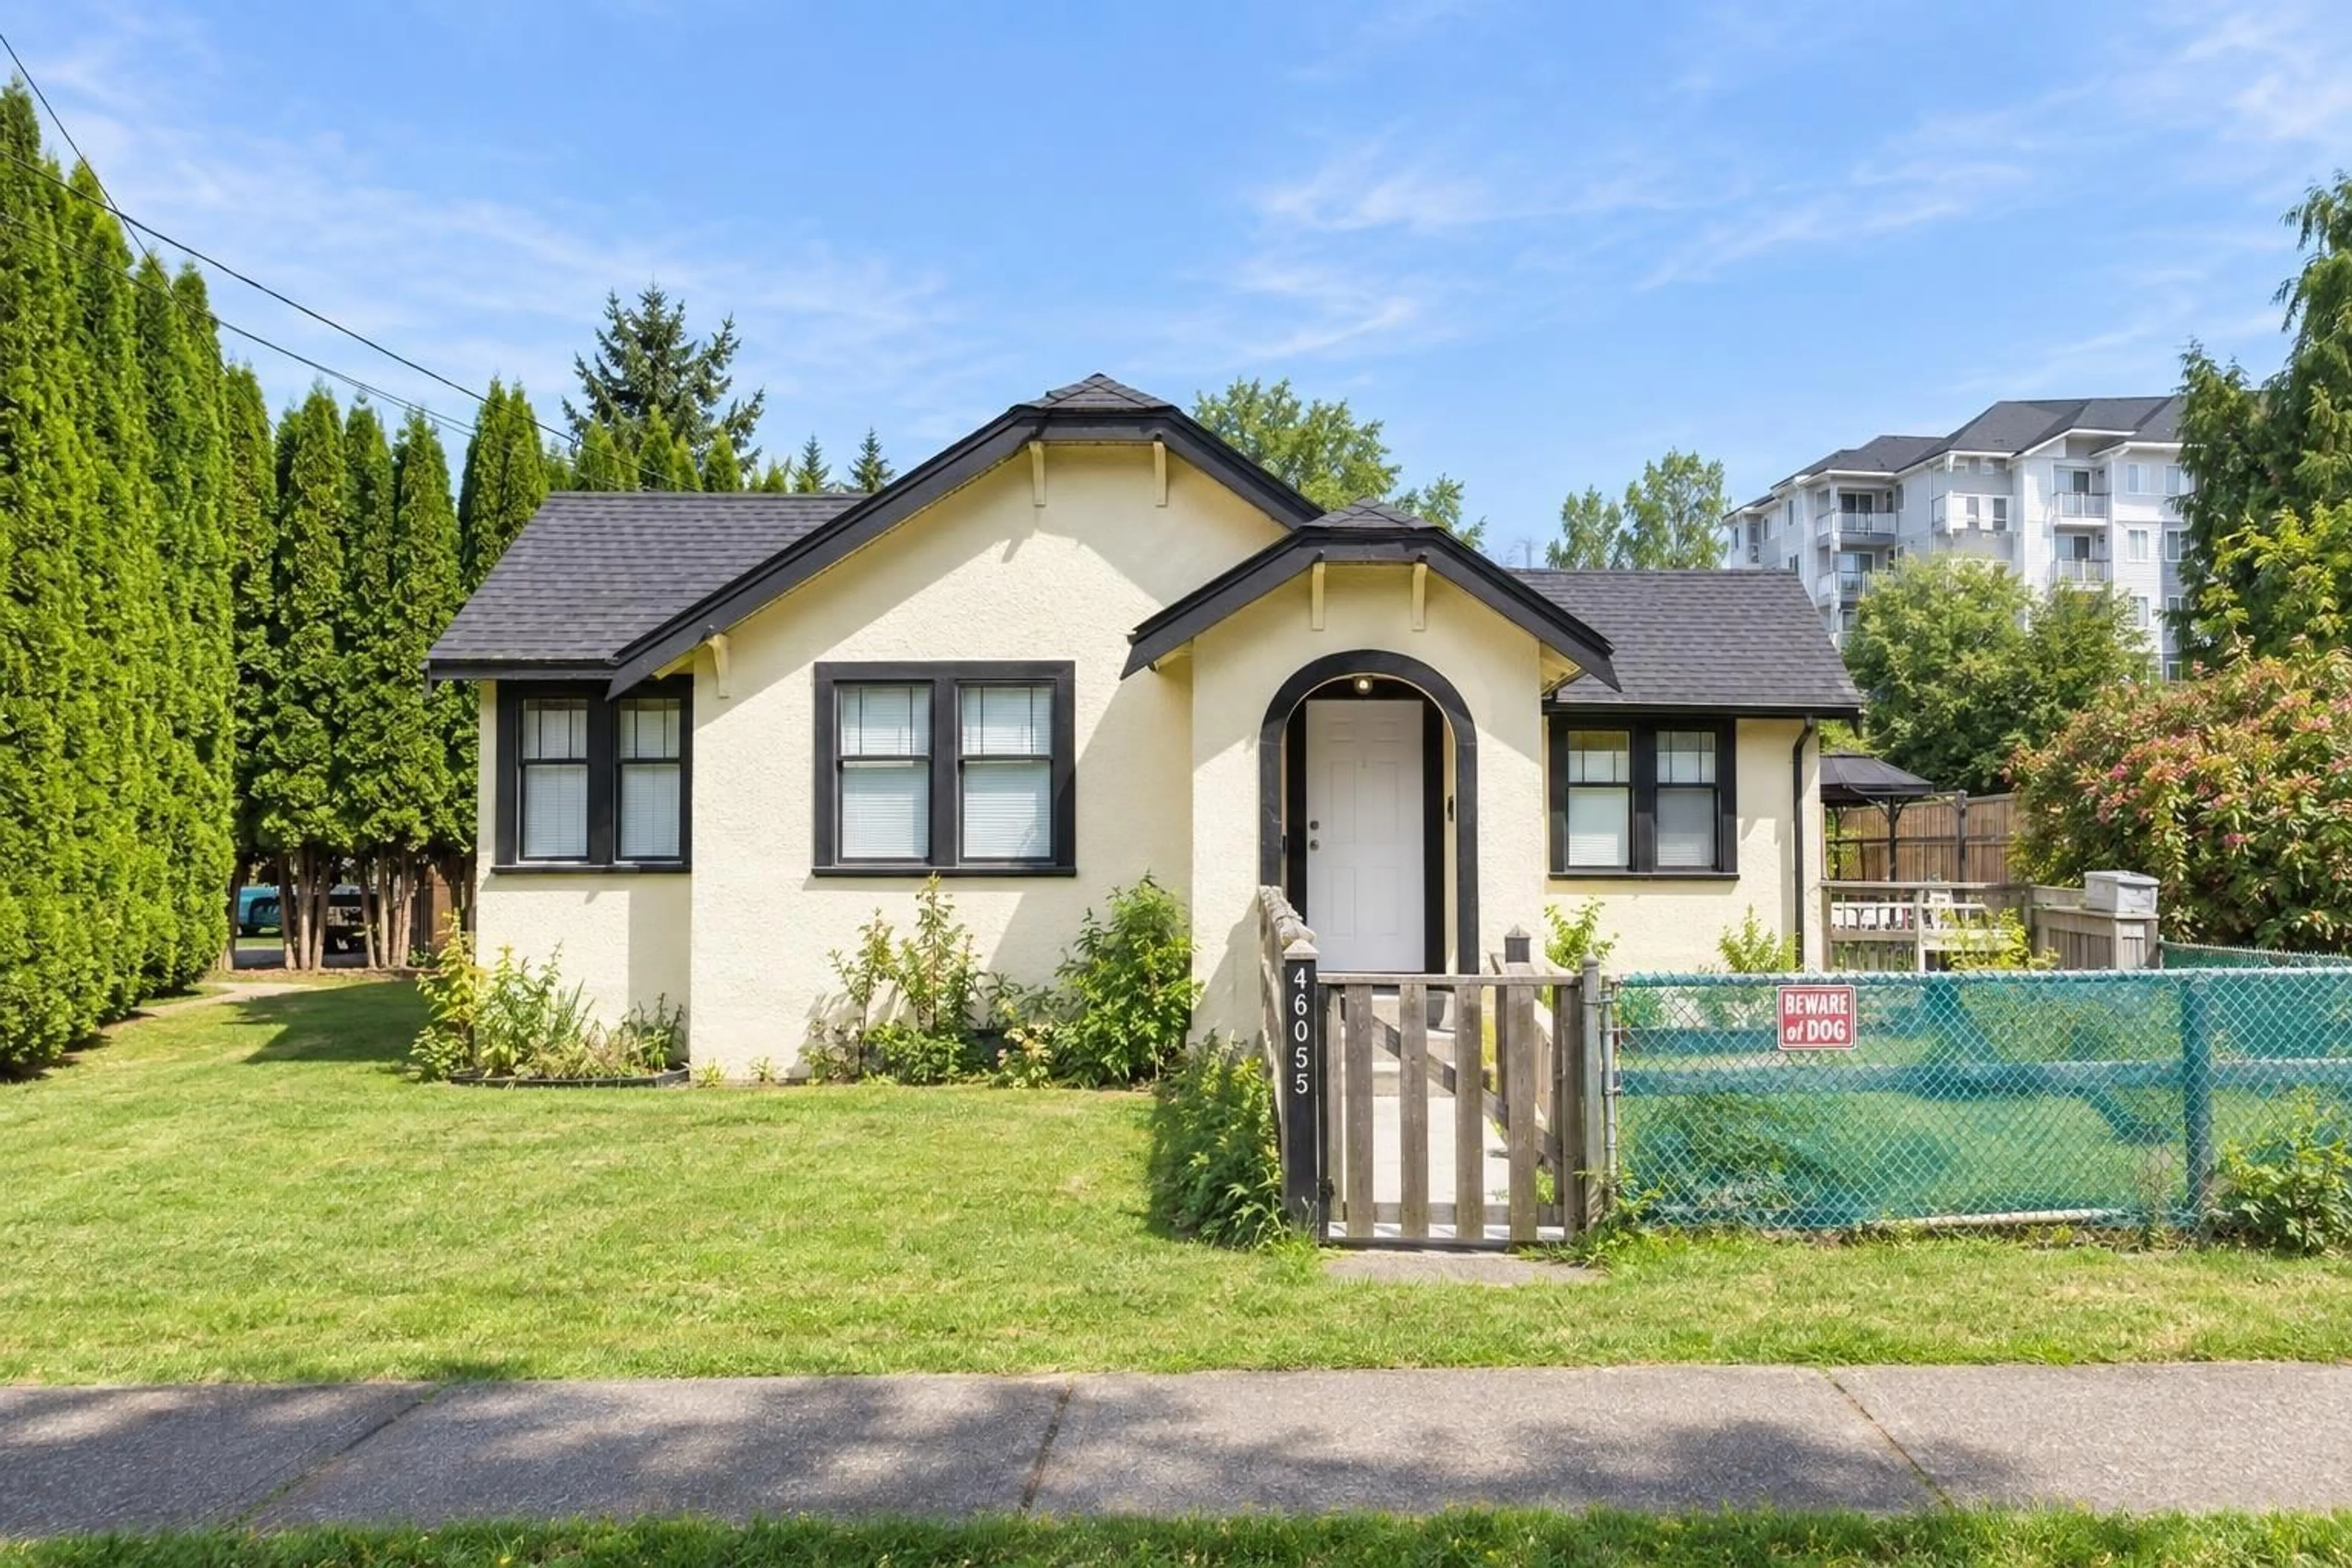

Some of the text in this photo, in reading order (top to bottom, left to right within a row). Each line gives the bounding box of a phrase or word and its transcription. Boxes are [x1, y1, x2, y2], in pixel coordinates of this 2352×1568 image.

[1785, 993, 1848, 1014] BEWARE
[1294, 967, 1308, 1095] 46055
[1787, 1019, 1846, 1042] of DOG
